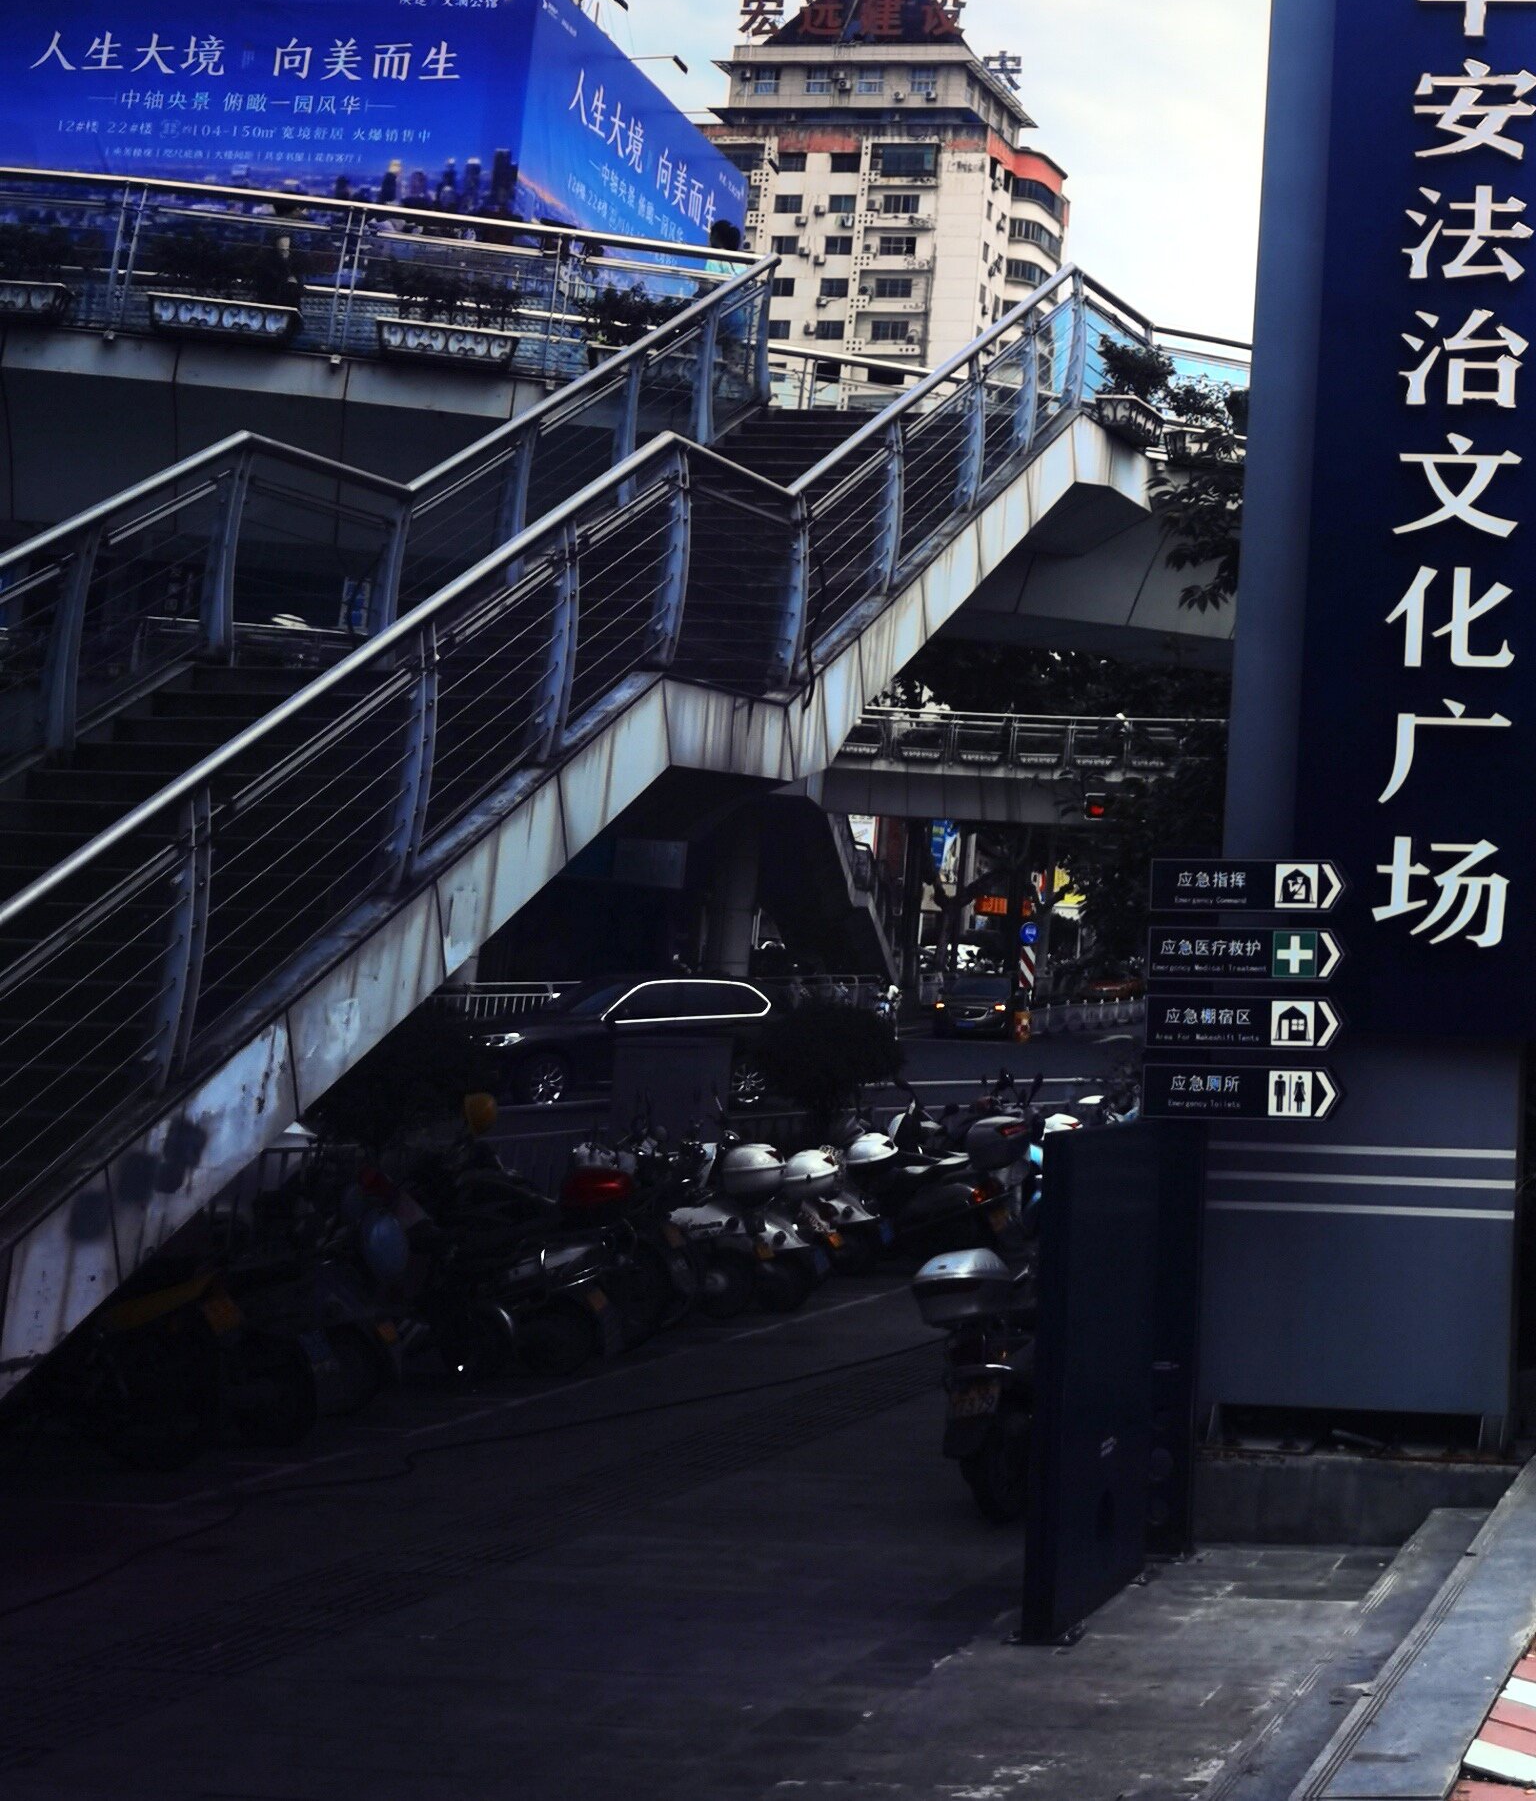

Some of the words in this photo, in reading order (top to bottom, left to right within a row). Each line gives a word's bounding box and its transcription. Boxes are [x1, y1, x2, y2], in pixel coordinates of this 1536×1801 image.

[29, 30, 226, 78] 人生大境
[272, 37, 463, 82] 向美而生
[121, 89, 210, 111] 中轴央景
[223, 92, 361, 115] 俯瞰一园风华
[568, 68, 645, 174] 人生大境
[656, 147, 717, 234] 向美而生
[1177, 871, 1247, 888] 应急指挥
[1160, 939, 1262, 957] 应急医疗救护
[1164, 1008, 1251, 1025] 应急棚宿区
[1170, 1075, 1241, 1093] 应急厕所
